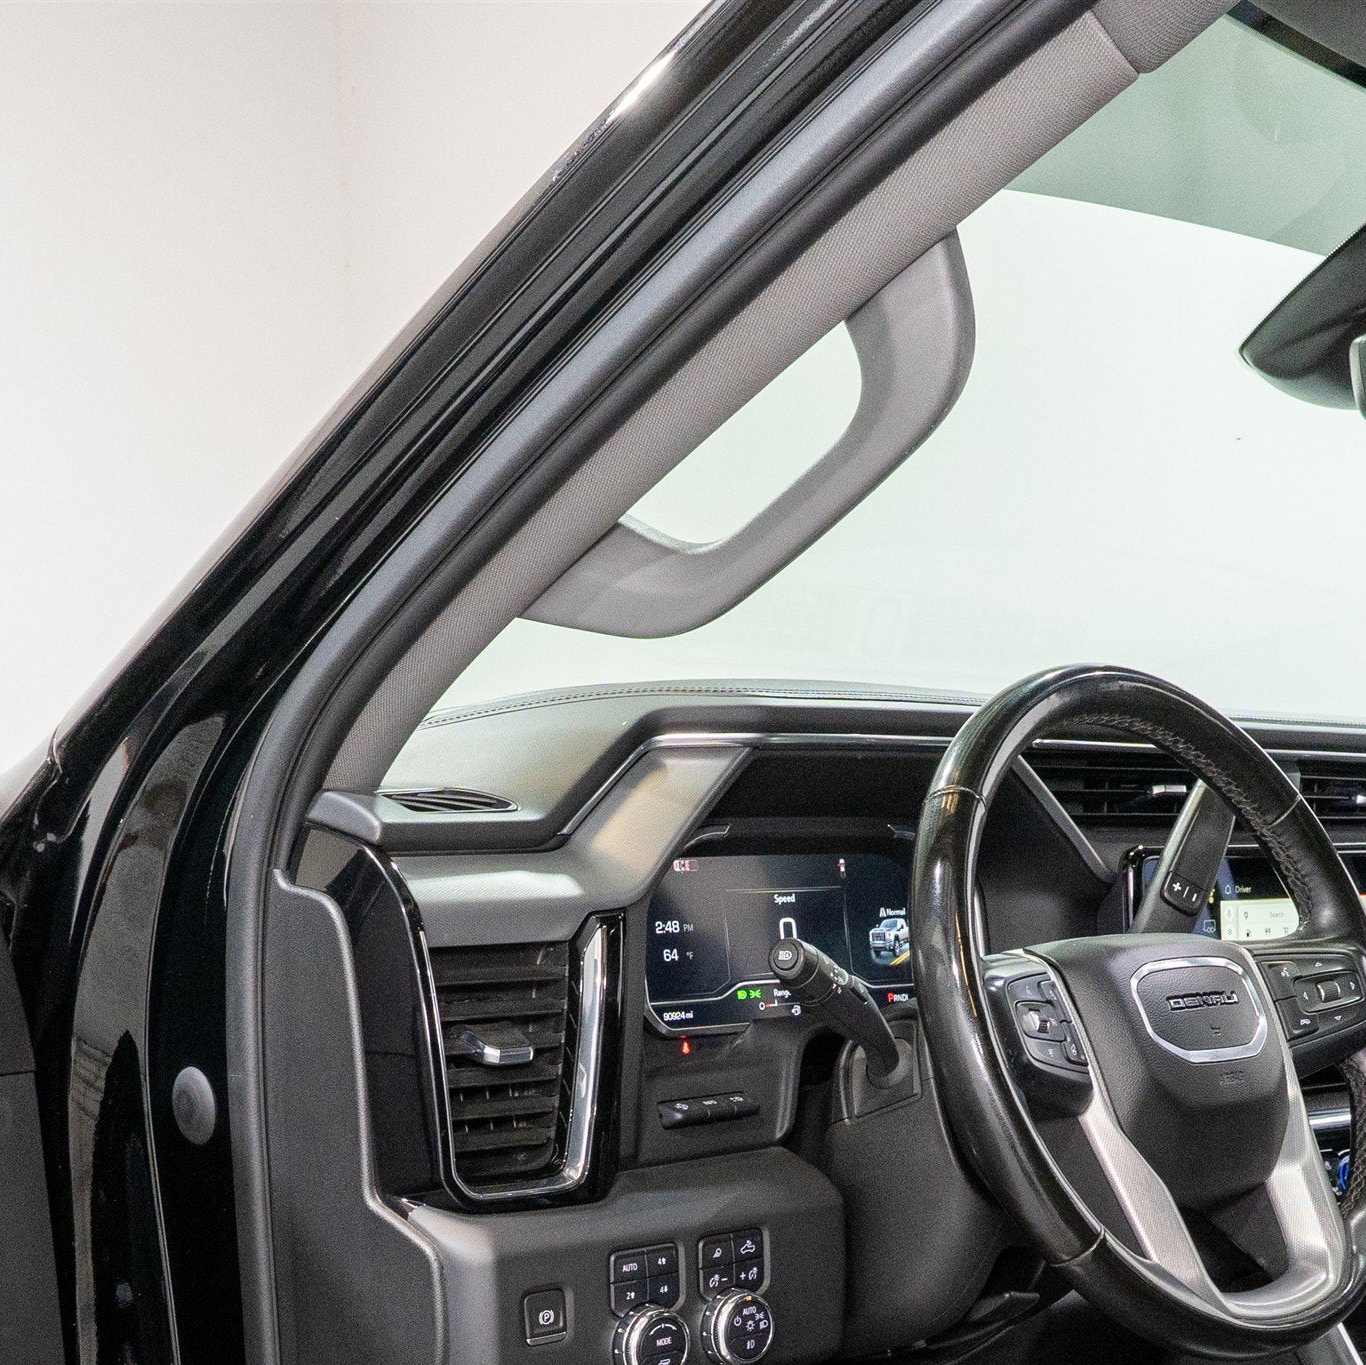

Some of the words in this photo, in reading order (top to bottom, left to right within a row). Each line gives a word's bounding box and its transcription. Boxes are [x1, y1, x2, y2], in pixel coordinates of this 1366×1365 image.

[1235, 885, 1252, 894] Driver
[773, 893, 796, 905] Speed
[655, 920, 681, 934] 2:48
[683, 923, 694, 932] PM
[663, 948, 679, 962] 64
[1166, 990, 1239, 1011] DENALI
[663, 1011, 685, 1021] 90924
[685, 1010, 694, 1019] mi
[622, 1263, 638, 1272] AUTO
[742, 1306, 757, 1316] AUTO
[656, 1336, 672, 1347] MODE
